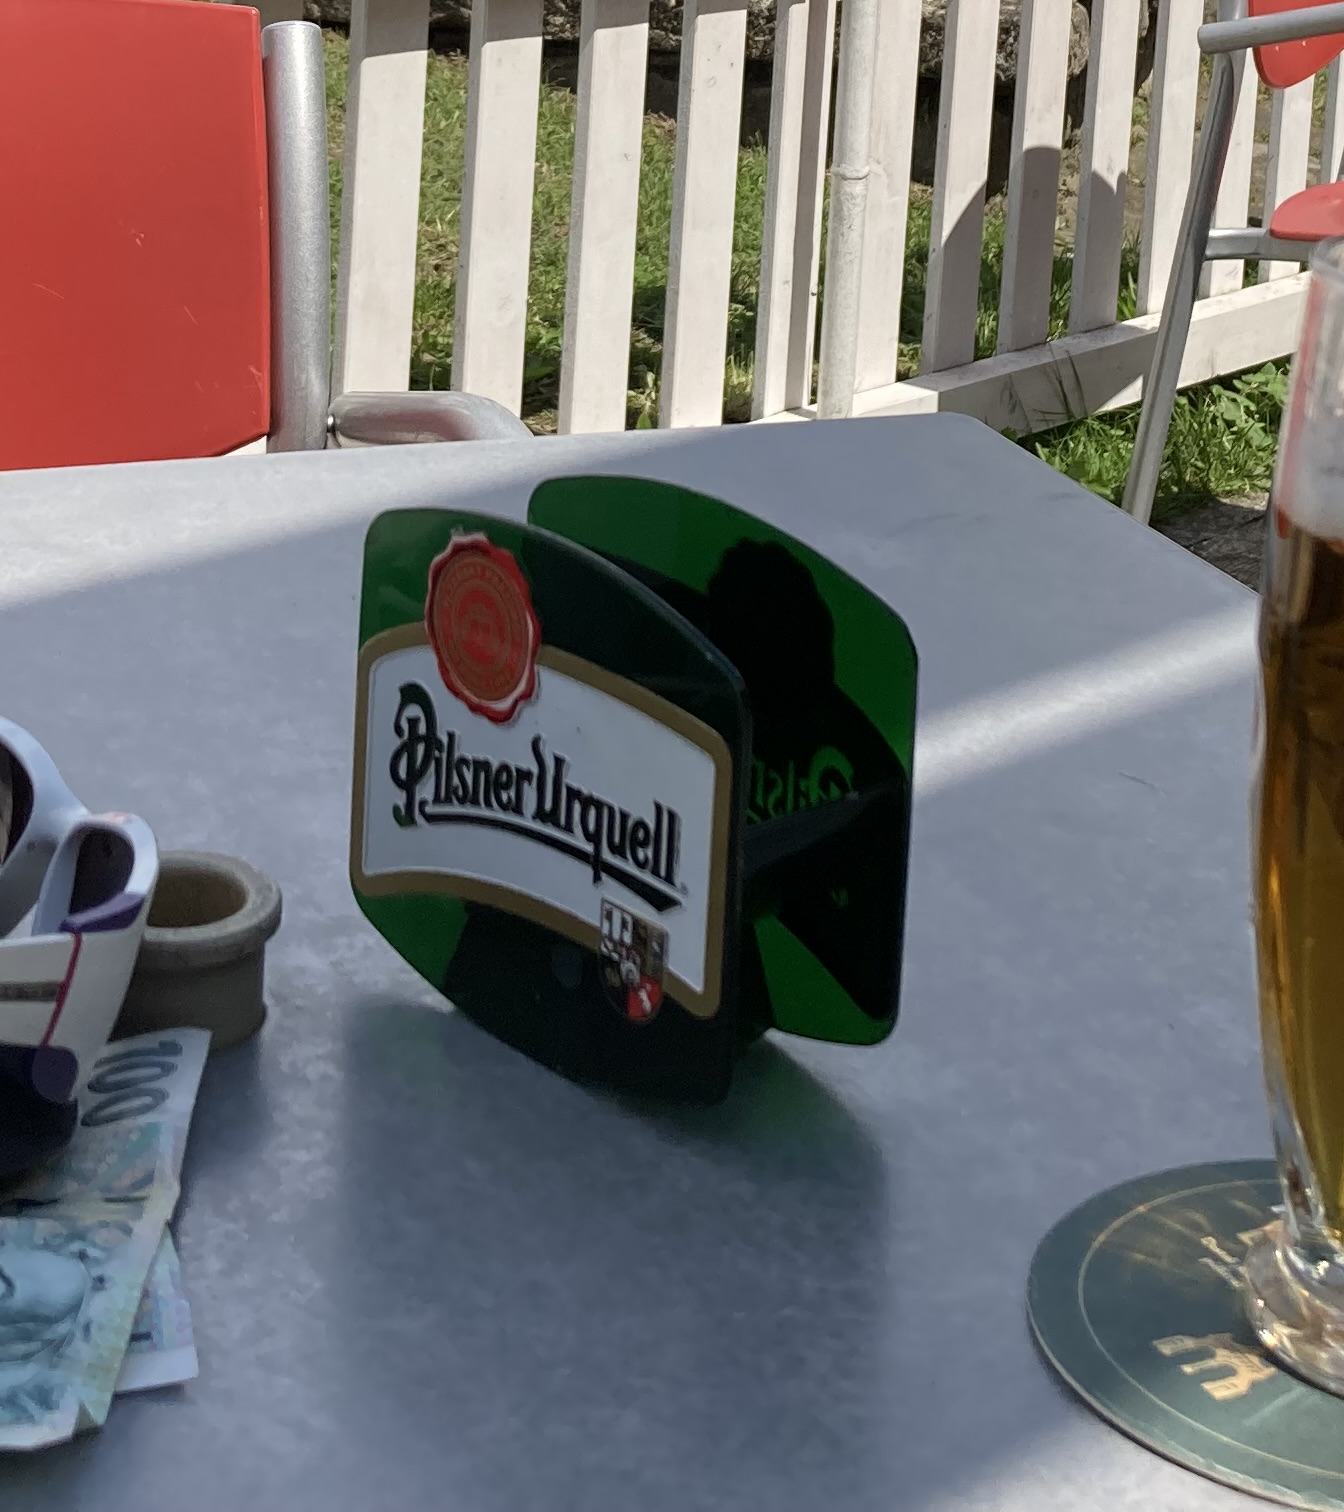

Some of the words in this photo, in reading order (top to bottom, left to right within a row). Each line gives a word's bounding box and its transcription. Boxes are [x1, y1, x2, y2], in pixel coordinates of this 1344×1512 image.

[389, 681, 535, 828] Pilsner
[531, 735, 682, 887] Urquell
[80, 1039, 185, 1129] 100
